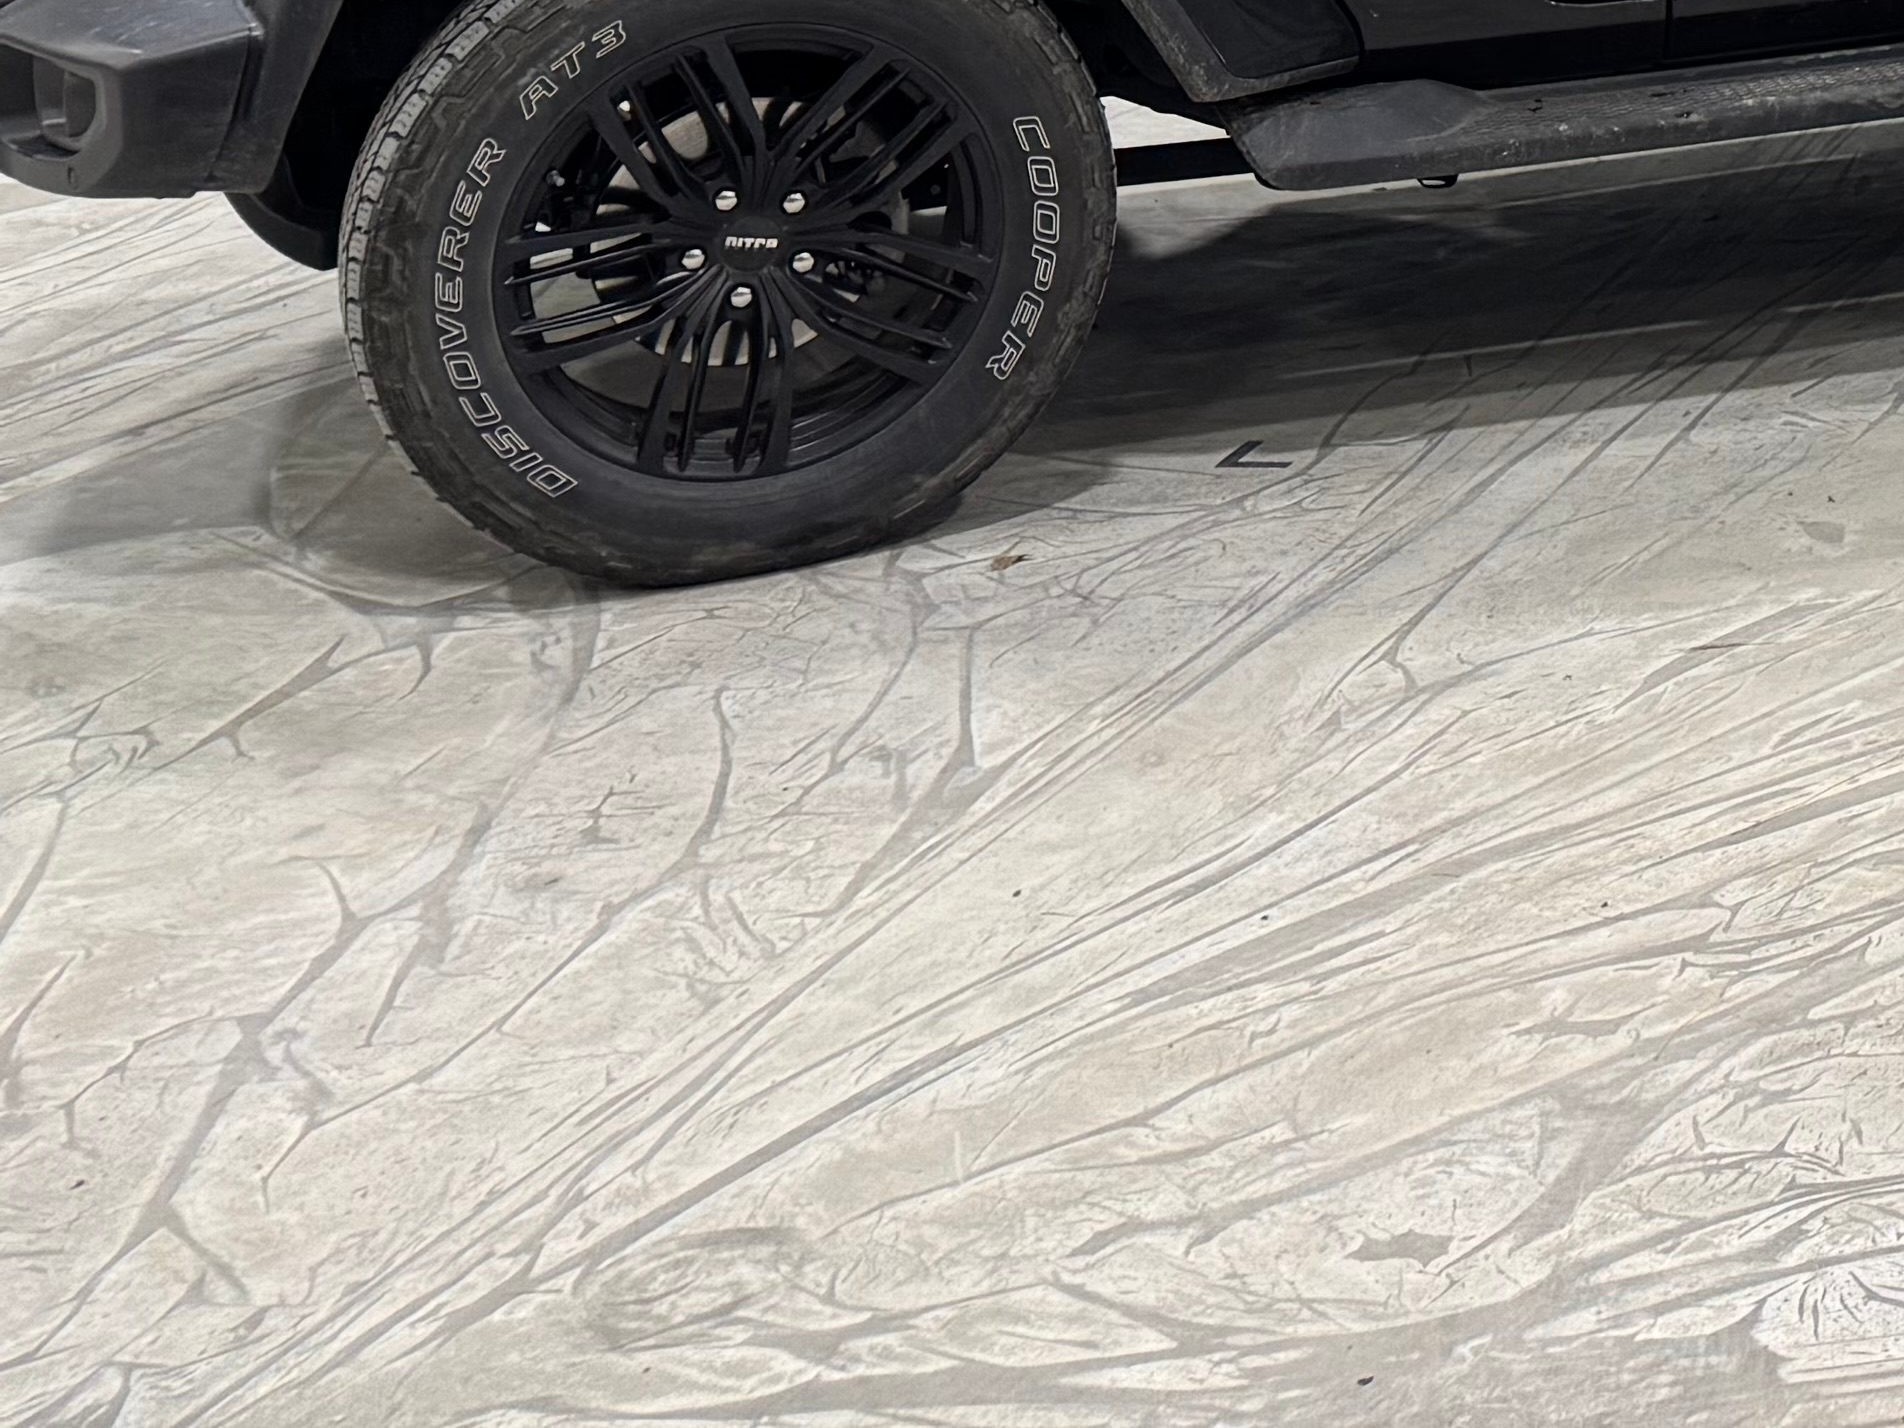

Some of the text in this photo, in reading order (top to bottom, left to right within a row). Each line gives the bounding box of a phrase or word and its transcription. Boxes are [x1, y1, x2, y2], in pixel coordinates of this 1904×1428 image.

[434, 19, 628, 499] DISCOVERER AT3
[984, 115, 1061, 381] COOPER
